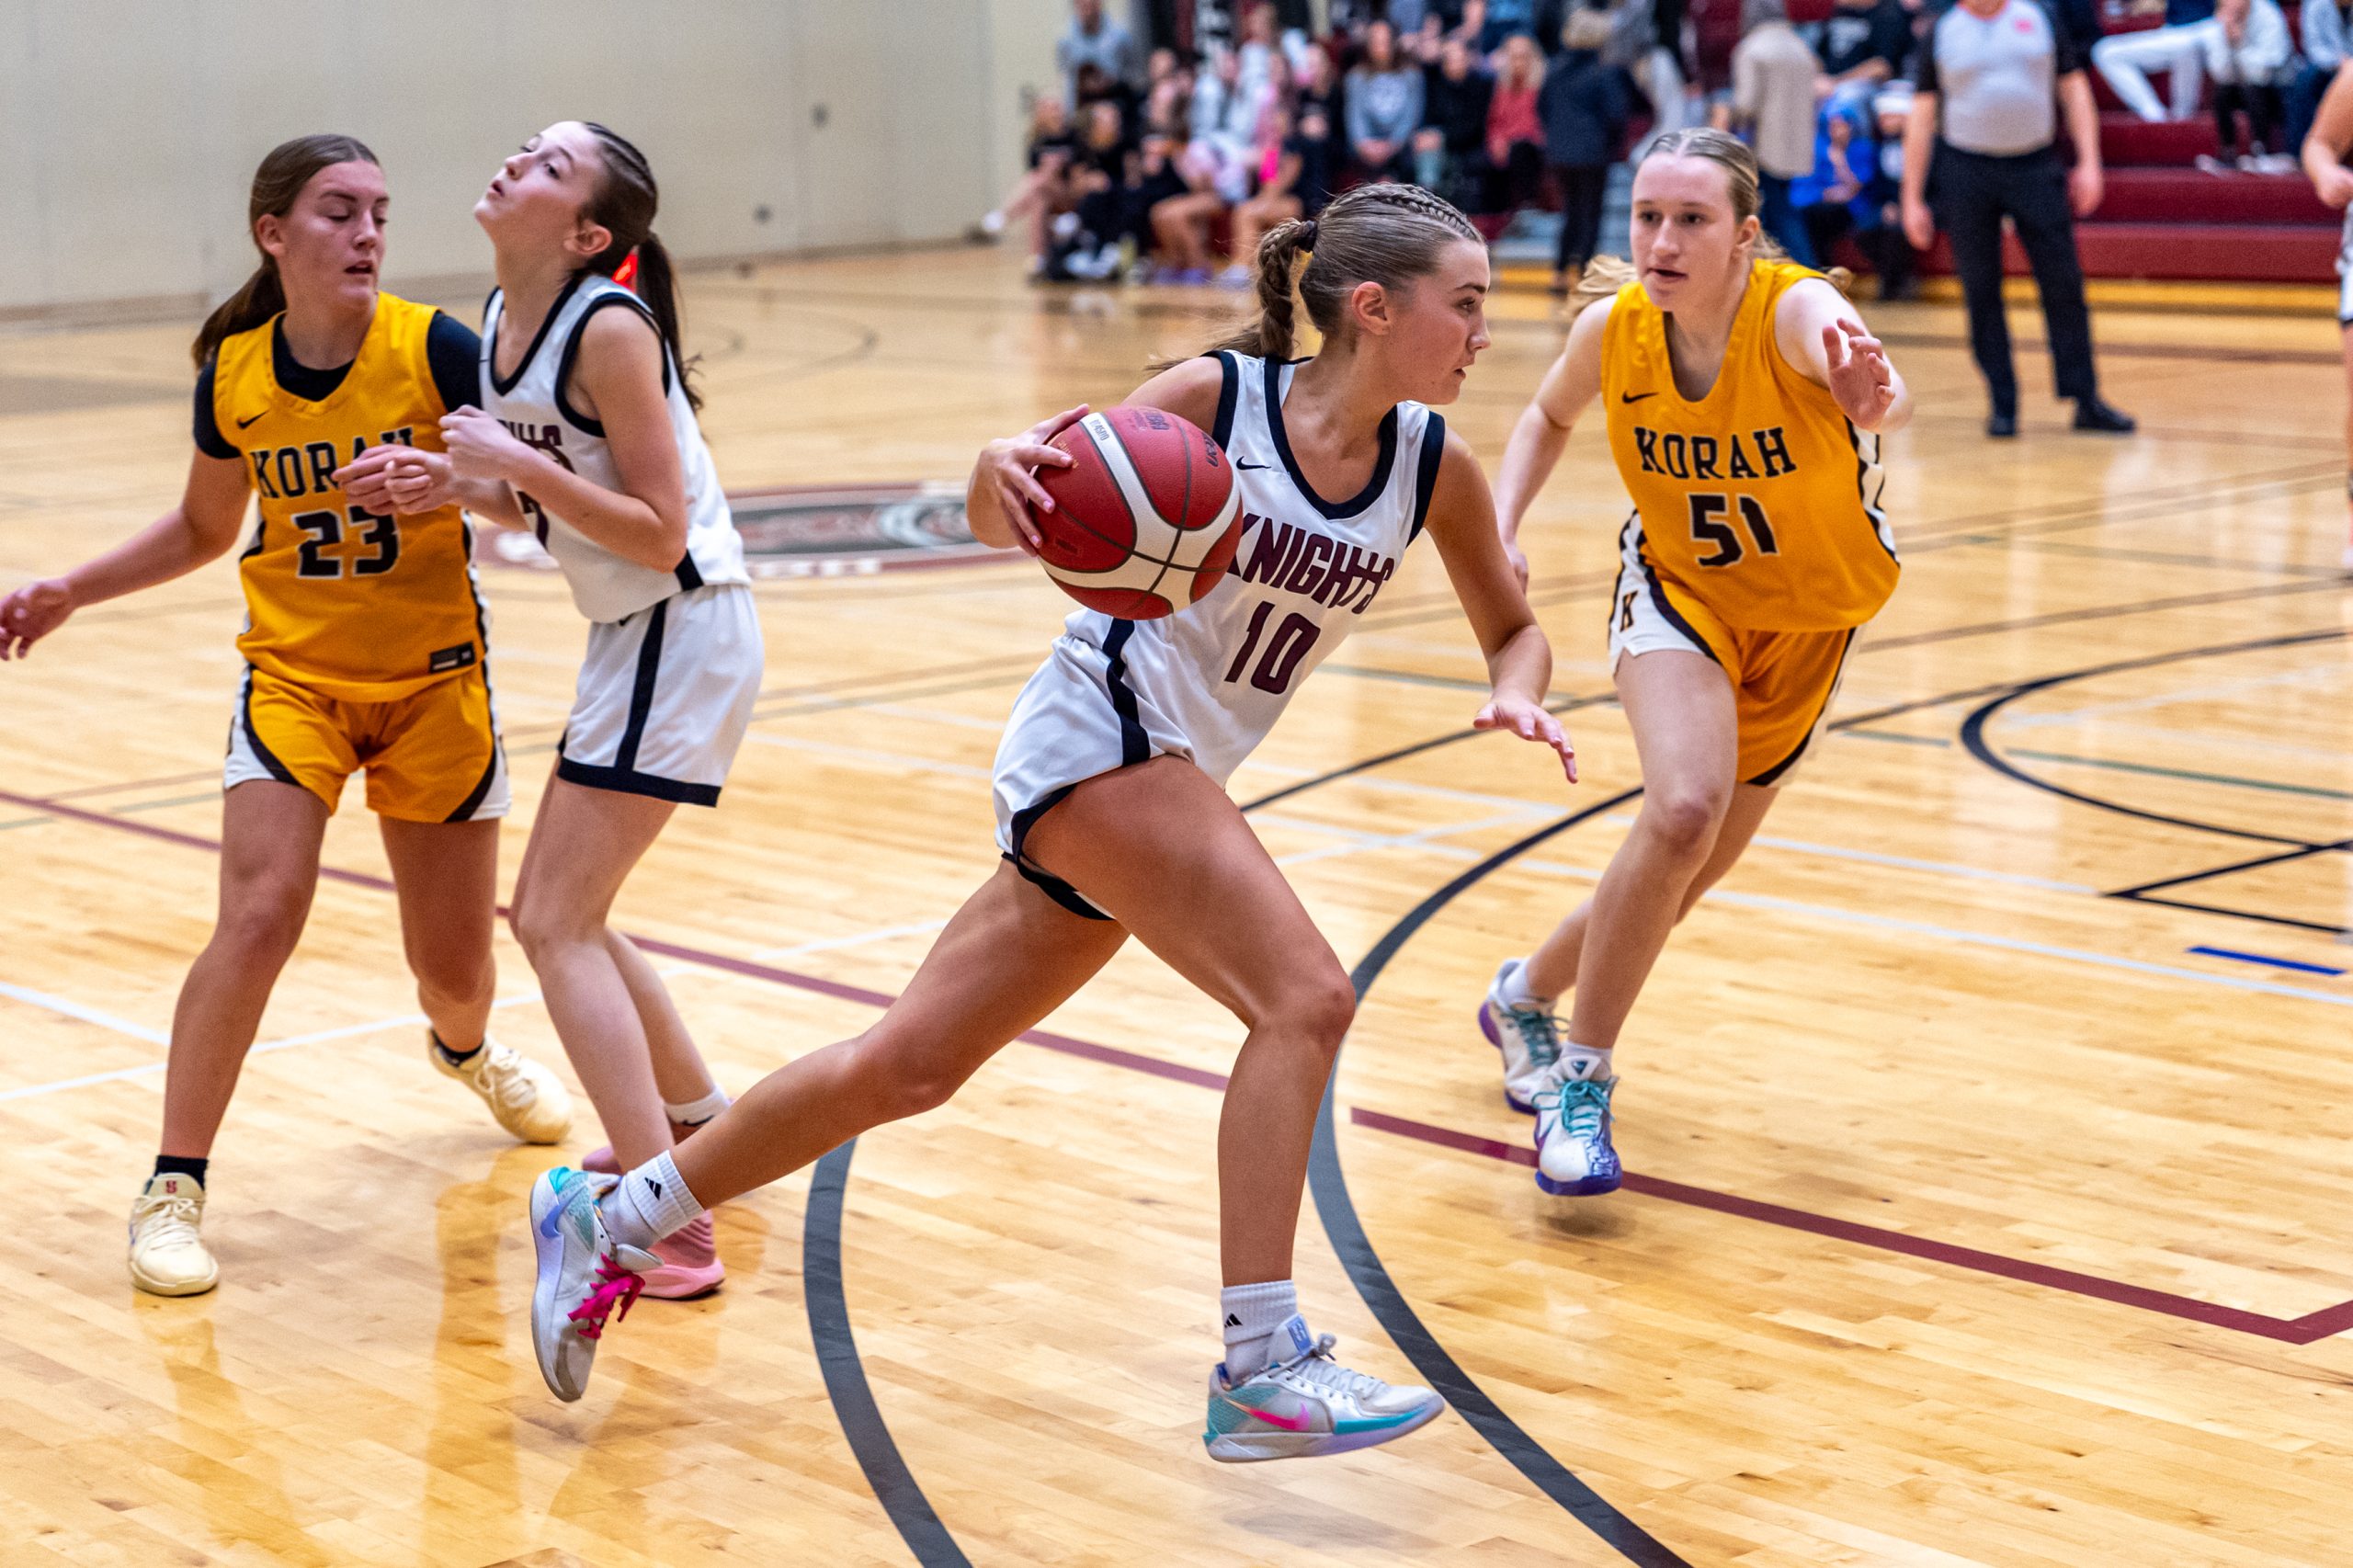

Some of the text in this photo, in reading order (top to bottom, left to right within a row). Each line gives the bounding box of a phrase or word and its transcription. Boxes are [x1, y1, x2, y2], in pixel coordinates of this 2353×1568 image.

[1634, 426, 1797, 480] KORAH
[291, 504, 403, 580] 23
[1688, 493, 1780, 567] 51
[1223, 600, 1322, 695] 10
[1620, 590, 1639, 632] K
